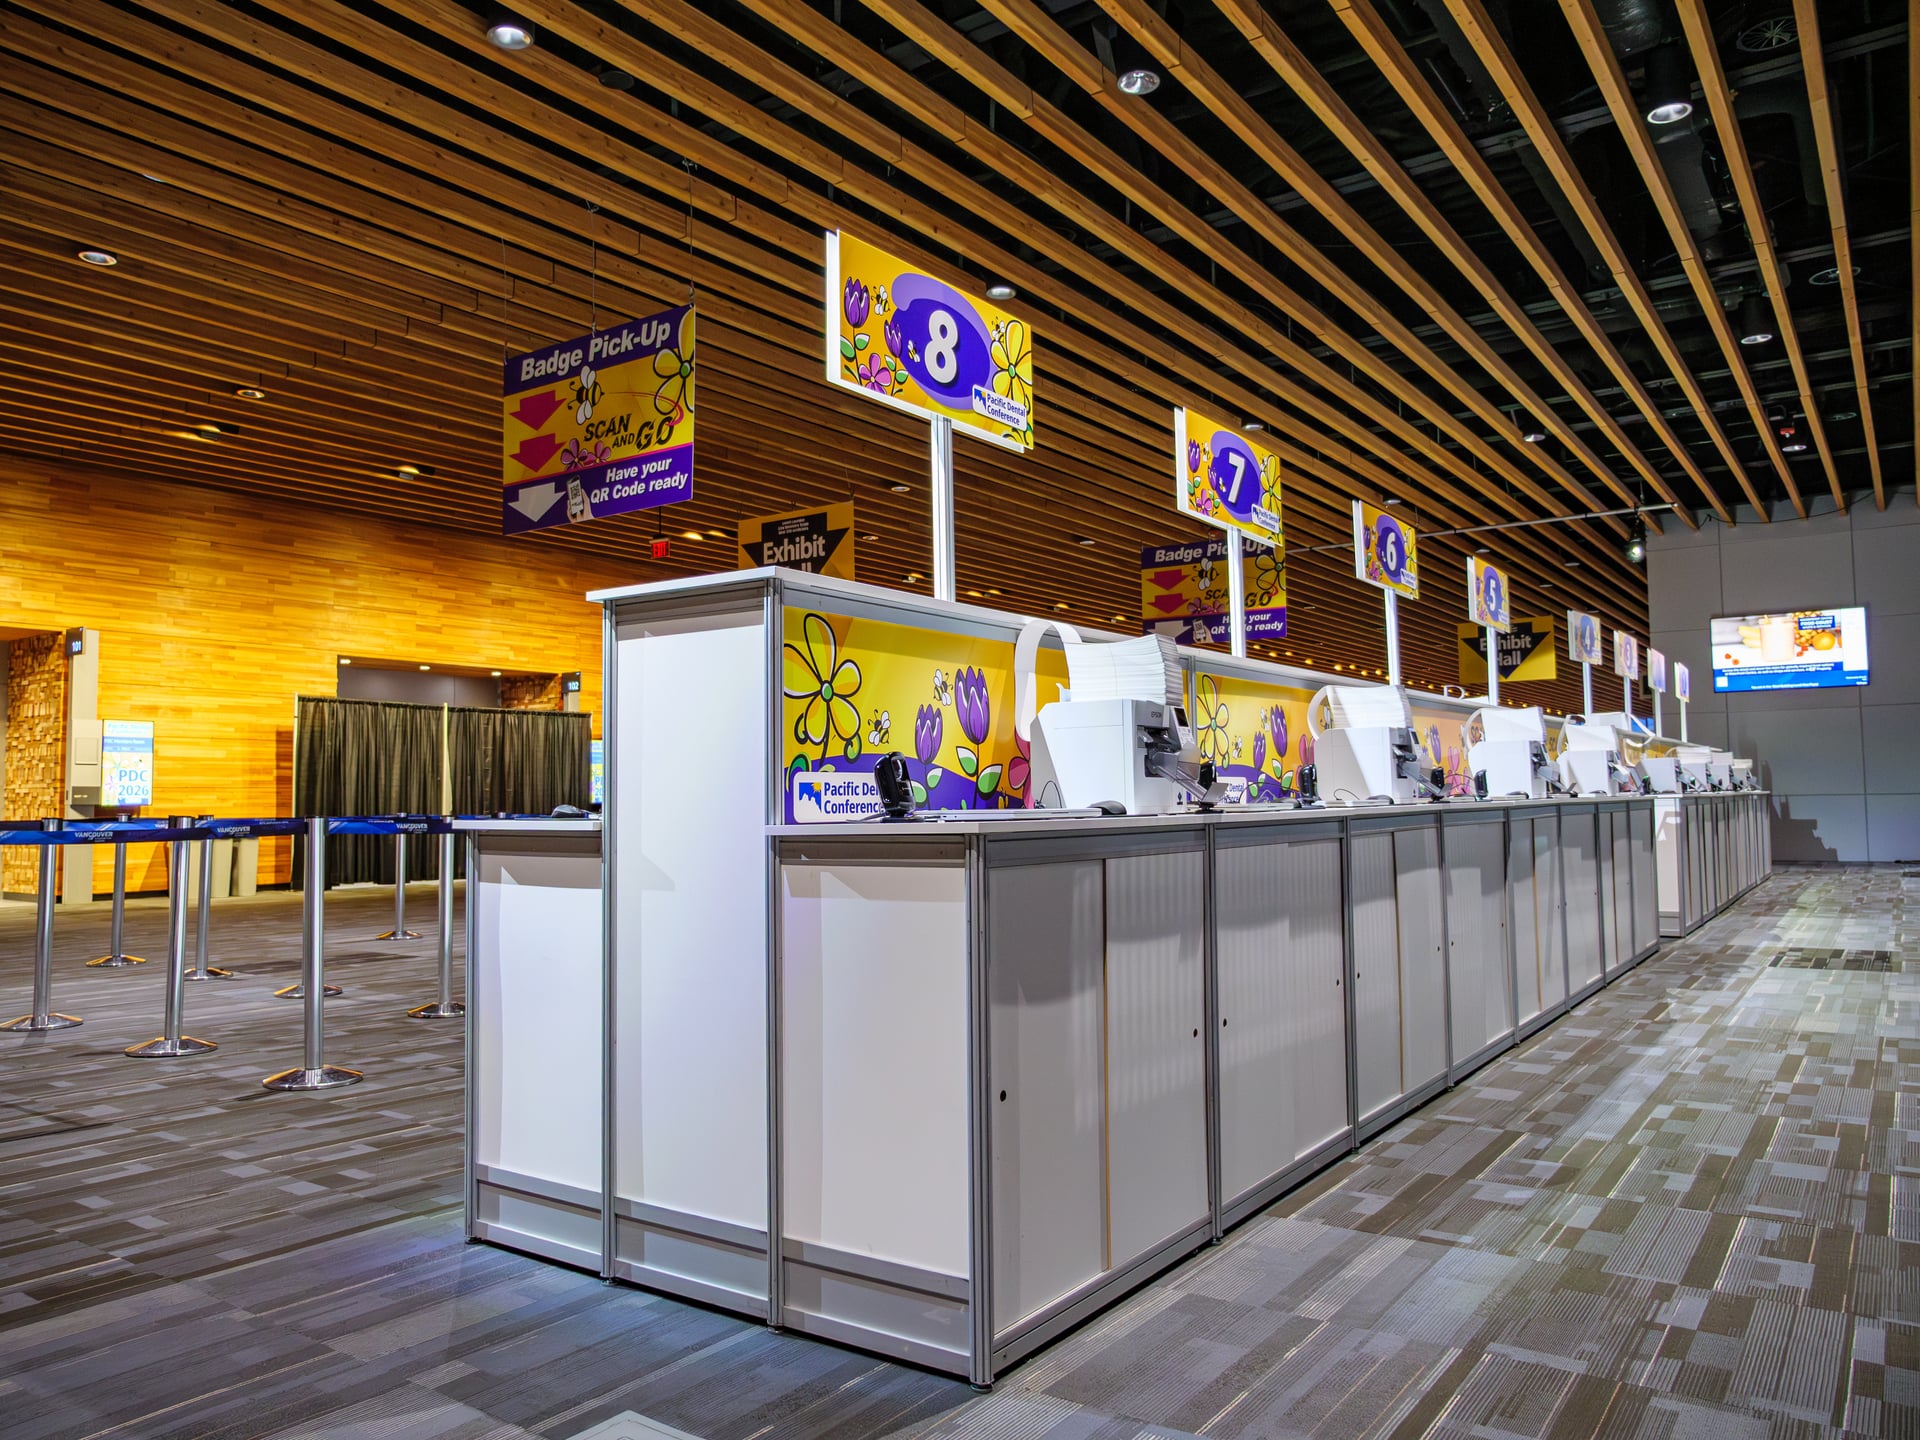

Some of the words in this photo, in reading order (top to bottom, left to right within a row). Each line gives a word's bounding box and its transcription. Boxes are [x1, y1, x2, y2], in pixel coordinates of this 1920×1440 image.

[521, 349, 583, 382] Badge
[588, 320, 671, 362] Pick-Up
[925, 310, 958, 384] 8
[987, 393, 1006, 409] Pacific
[1007, 402, 1026, 417] Dental
[987, 405, 1020, 425] Conference
[584, 413, 632, 442] SCAN
[612, 433, 635, 448] AND
[636, 416, 674, 452] GO
[606, 466, 638, 483] Have
[641, 458, 672, 479] your
[1228, 452, 1245, 504] 7
[590, 487, 610, 504] QR
[612, 481, 646, 499] Code
[649, 472, 688, 492] ready
[764, 535, 826, 565] Exhibit
[1155, 547, 1202, 563] Badge
[1386, 532, 1397, 571] 6
[1244, 591, 1271, 608] GO
[1489, 579, 1497, 612] 5
[1248, 613, 1271, 624] your
[1254, 621, 1284, 631] ready
[1211, 625, 1225, 635] QR
[1584, 625, 1591, 651] 4
[72, 641, 82, 652] 101
[1480, 634, 1532, 651] Ehibit
[568, 681, 579, 691] 102
[118, 769, 148, 783] PDC
[118, 784, 149, 796] 2026
[824, 781, 860, 797] Pacific
[217, 826, 251, 834] VANCOUVER
[396, 822, 428, 831] VANCOUVER
[74, 831, 114, 840] VANCOUVER
